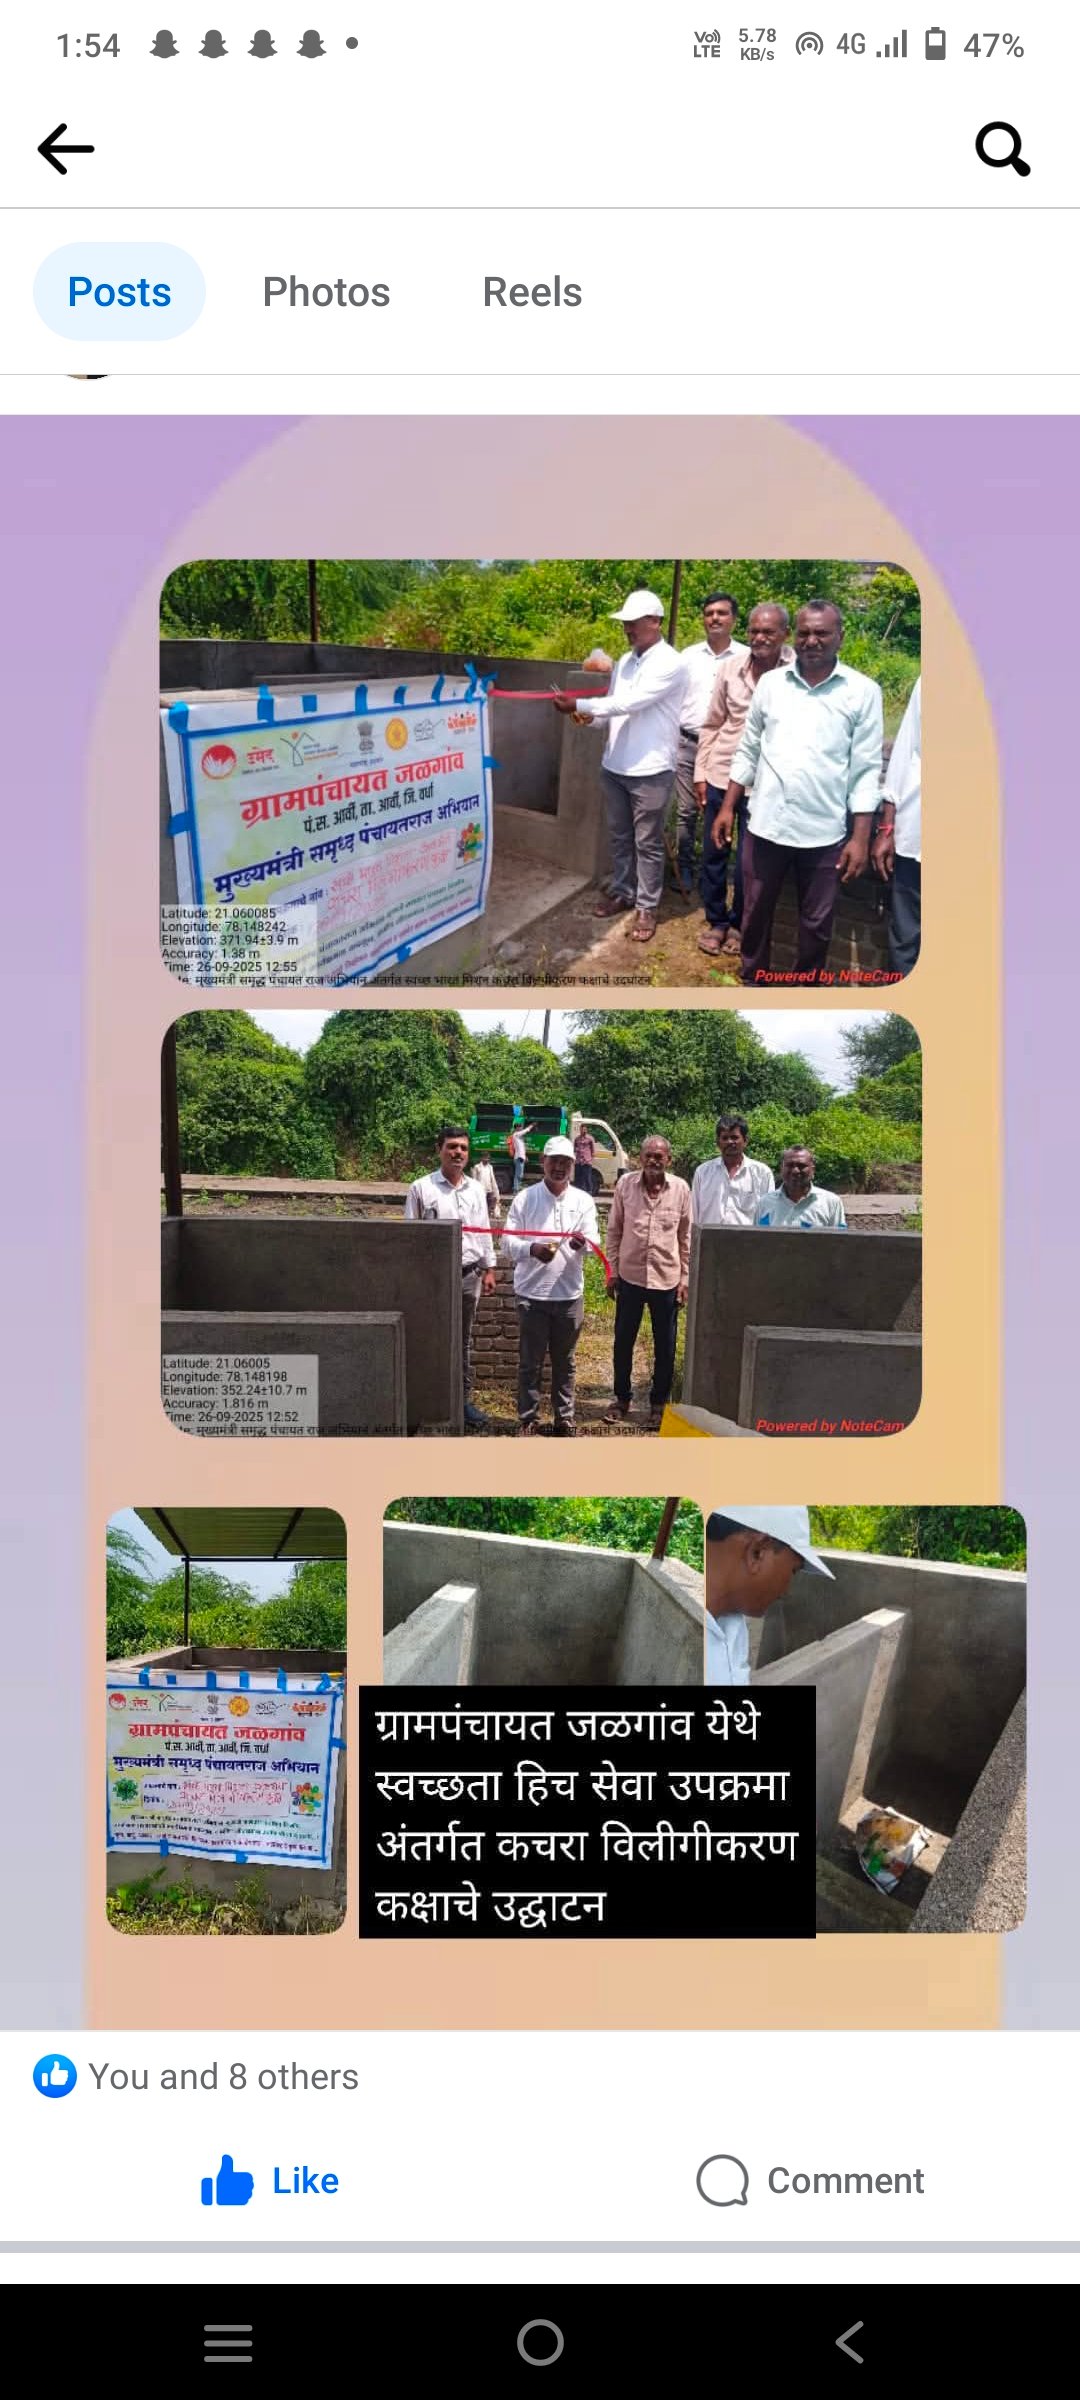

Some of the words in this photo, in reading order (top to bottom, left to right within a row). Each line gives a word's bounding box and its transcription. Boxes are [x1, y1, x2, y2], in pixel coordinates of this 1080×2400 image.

[57, 33, 120, 58] 1:54
[739, 28, 776, 43] 5.78
[836, 33, 866, 55] 4G
[963, 33, 1025, 58] 47%
[694, 45, 721, 58] LTE
[740, 48, 775, 62] KB/s
[69, 277, 171, 308] Posts
[264, 275, 390, 308] Photos
[484, 275, 583, 308] Reels
[240, 770, 388, 829] ग्रामपंचायत
[395, 747, 466, 784] जळगांव
[213, 847, 304, 903] मुख्यमंत्री
[359, 809, 433, 844] पंचायतराज
[437, 794, 480, 820] अभियान
[88, 2063, 148, 2091] You
[161, 2062, 218, 2091] and
[229, 2063, 248, 2091] 8
[258, 2062, 359, 2091] others
[273, 2166, 340, 2195] Like
[767, 2166, 925, 2195] Comment
